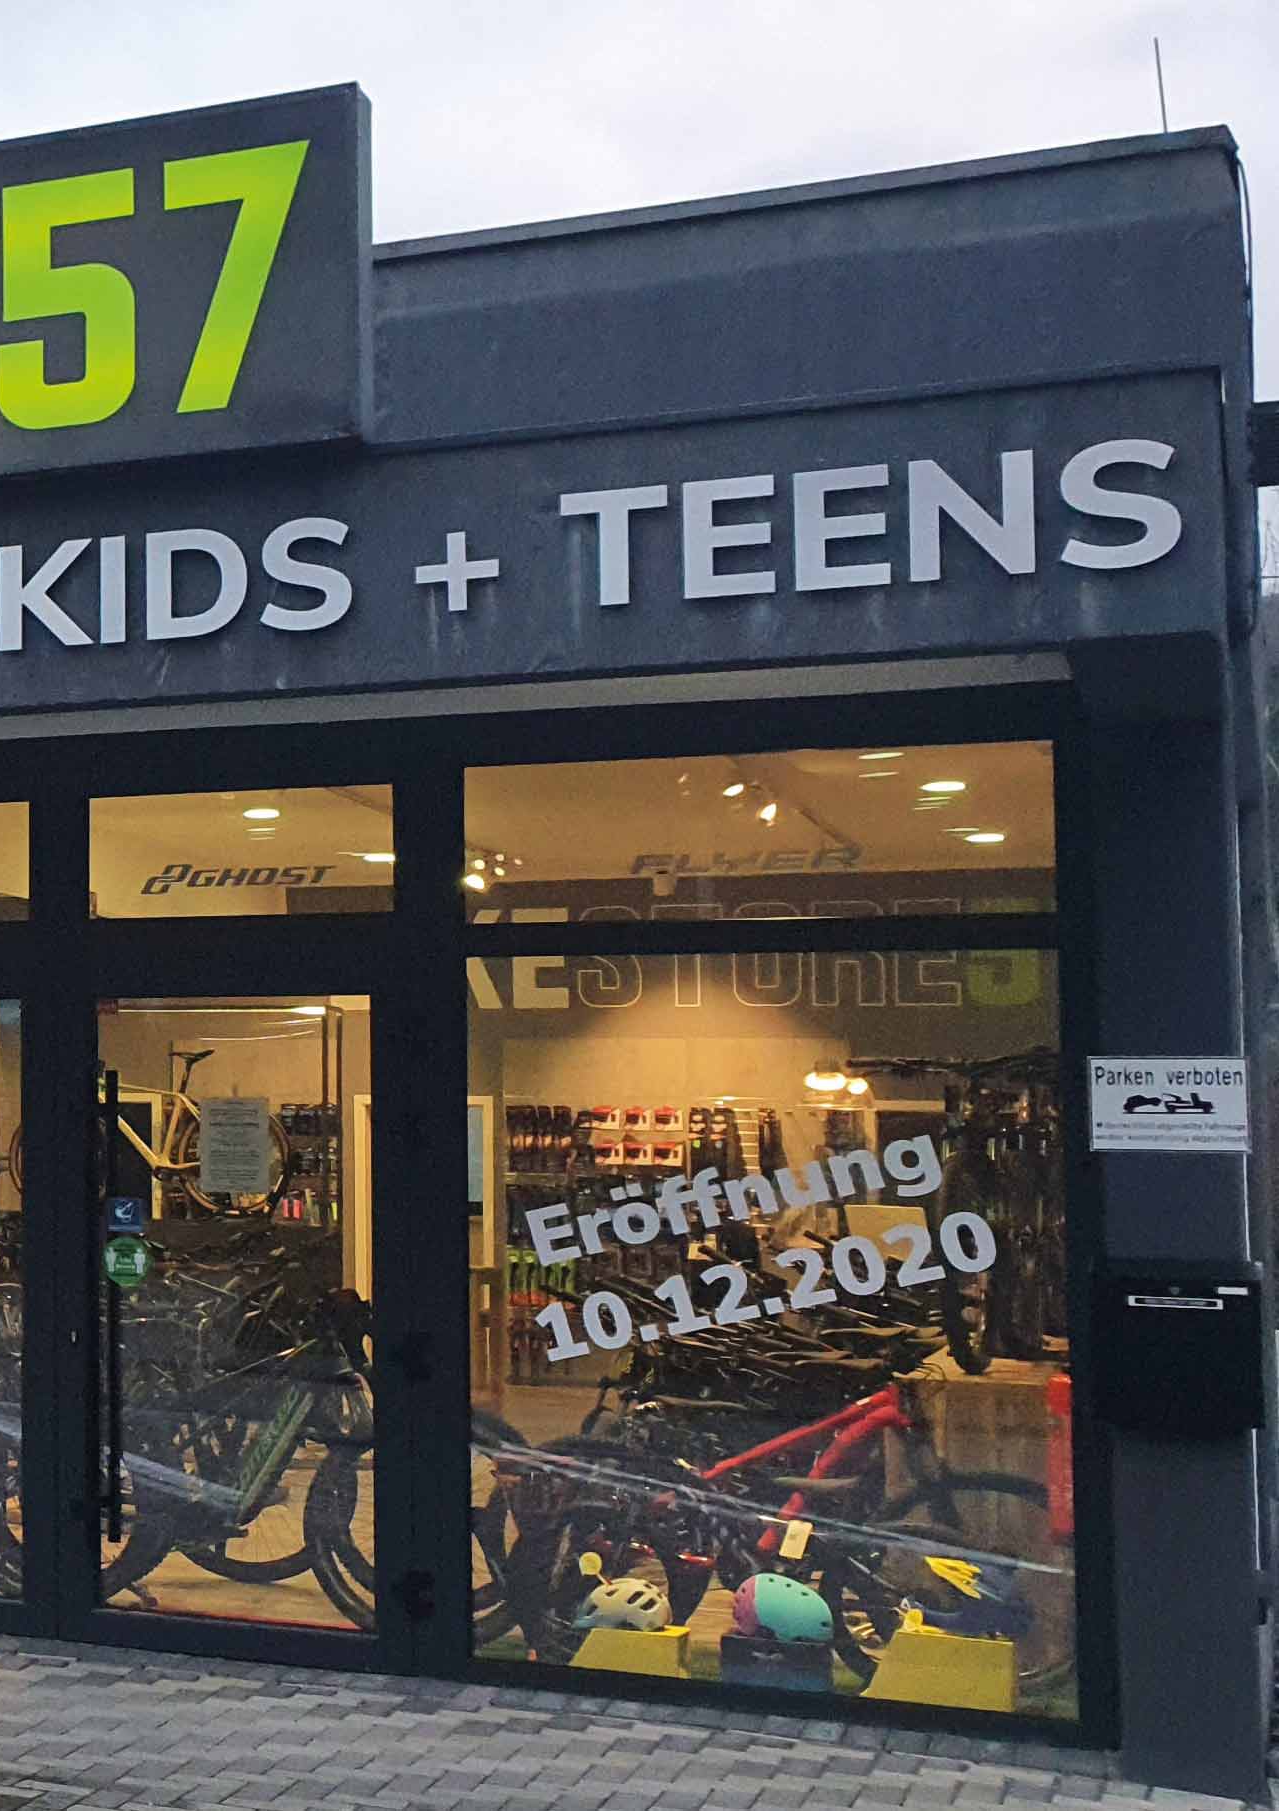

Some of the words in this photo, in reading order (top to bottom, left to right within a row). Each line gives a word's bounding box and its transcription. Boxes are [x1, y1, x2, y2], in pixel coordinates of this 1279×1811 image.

[414, 531, 500, 612] +
[559, 438, 1182, 606] TEENS
[192, 864, 338, 889] GHOST
[1094, 1066, 1155, 1086] Parken
[1166, 1066, 1243, 1086] verboten
[525, 1134, 943, 1266] Eröffnung
[535, 1211, 997, 1362] 10.12.2020
